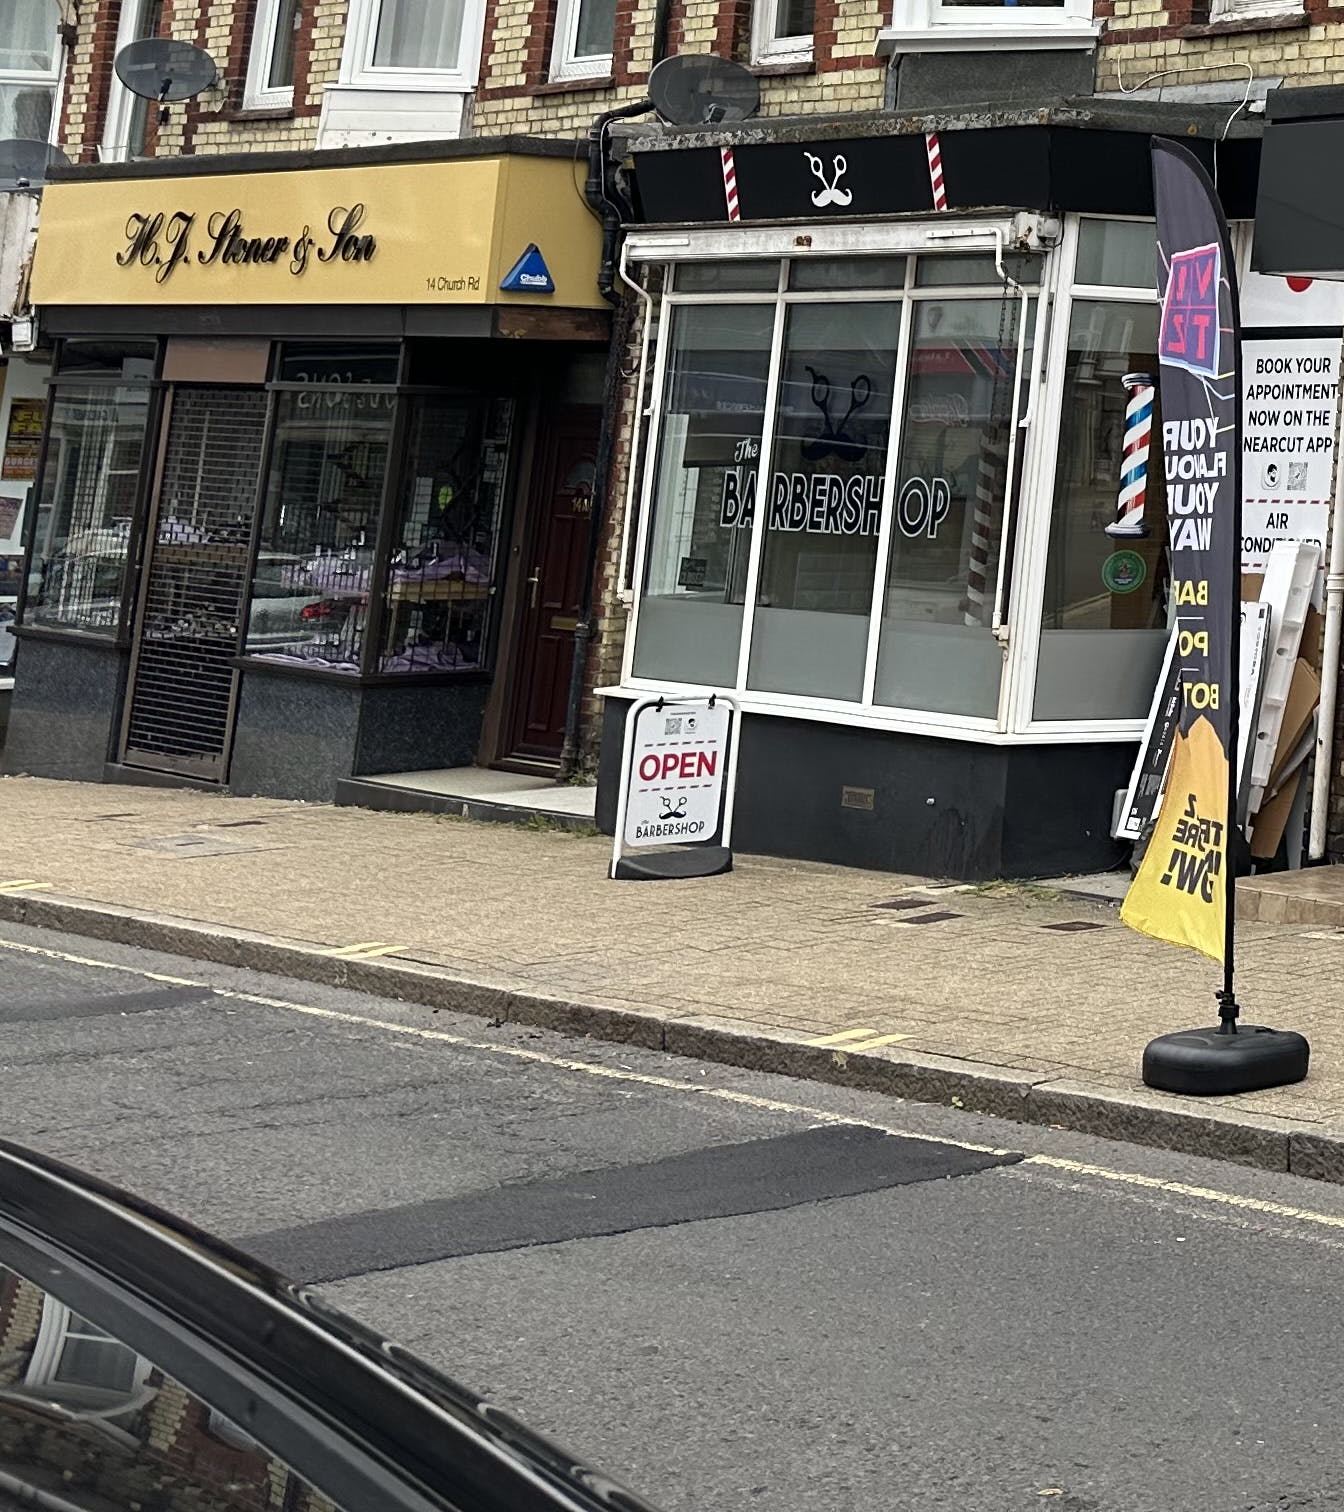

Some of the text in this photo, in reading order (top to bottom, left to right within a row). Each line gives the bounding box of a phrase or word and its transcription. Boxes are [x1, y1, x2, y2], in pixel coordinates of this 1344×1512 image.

[198, 208, 289, 266] Stoner
[289, 225, 315, 275] &
[317, 203, 377, 263] Son
[426, 276, 481, 290] 14 Church Rd
[1255, 357, 1331, 375] BOOK YOUR
[1246, 384, 1338, 401] APPOINTMENT
[1248, 410, 1330, 427] NOW ON THE
[734, 438, 759, 462] The
[1243, 437, 1333, 454] NEARCUT APP
[1266, 513, 1289, 530] AIR
[639, 751, 718, 781] OPEN
[636, 821, 705, 839] BARBERSHOP
